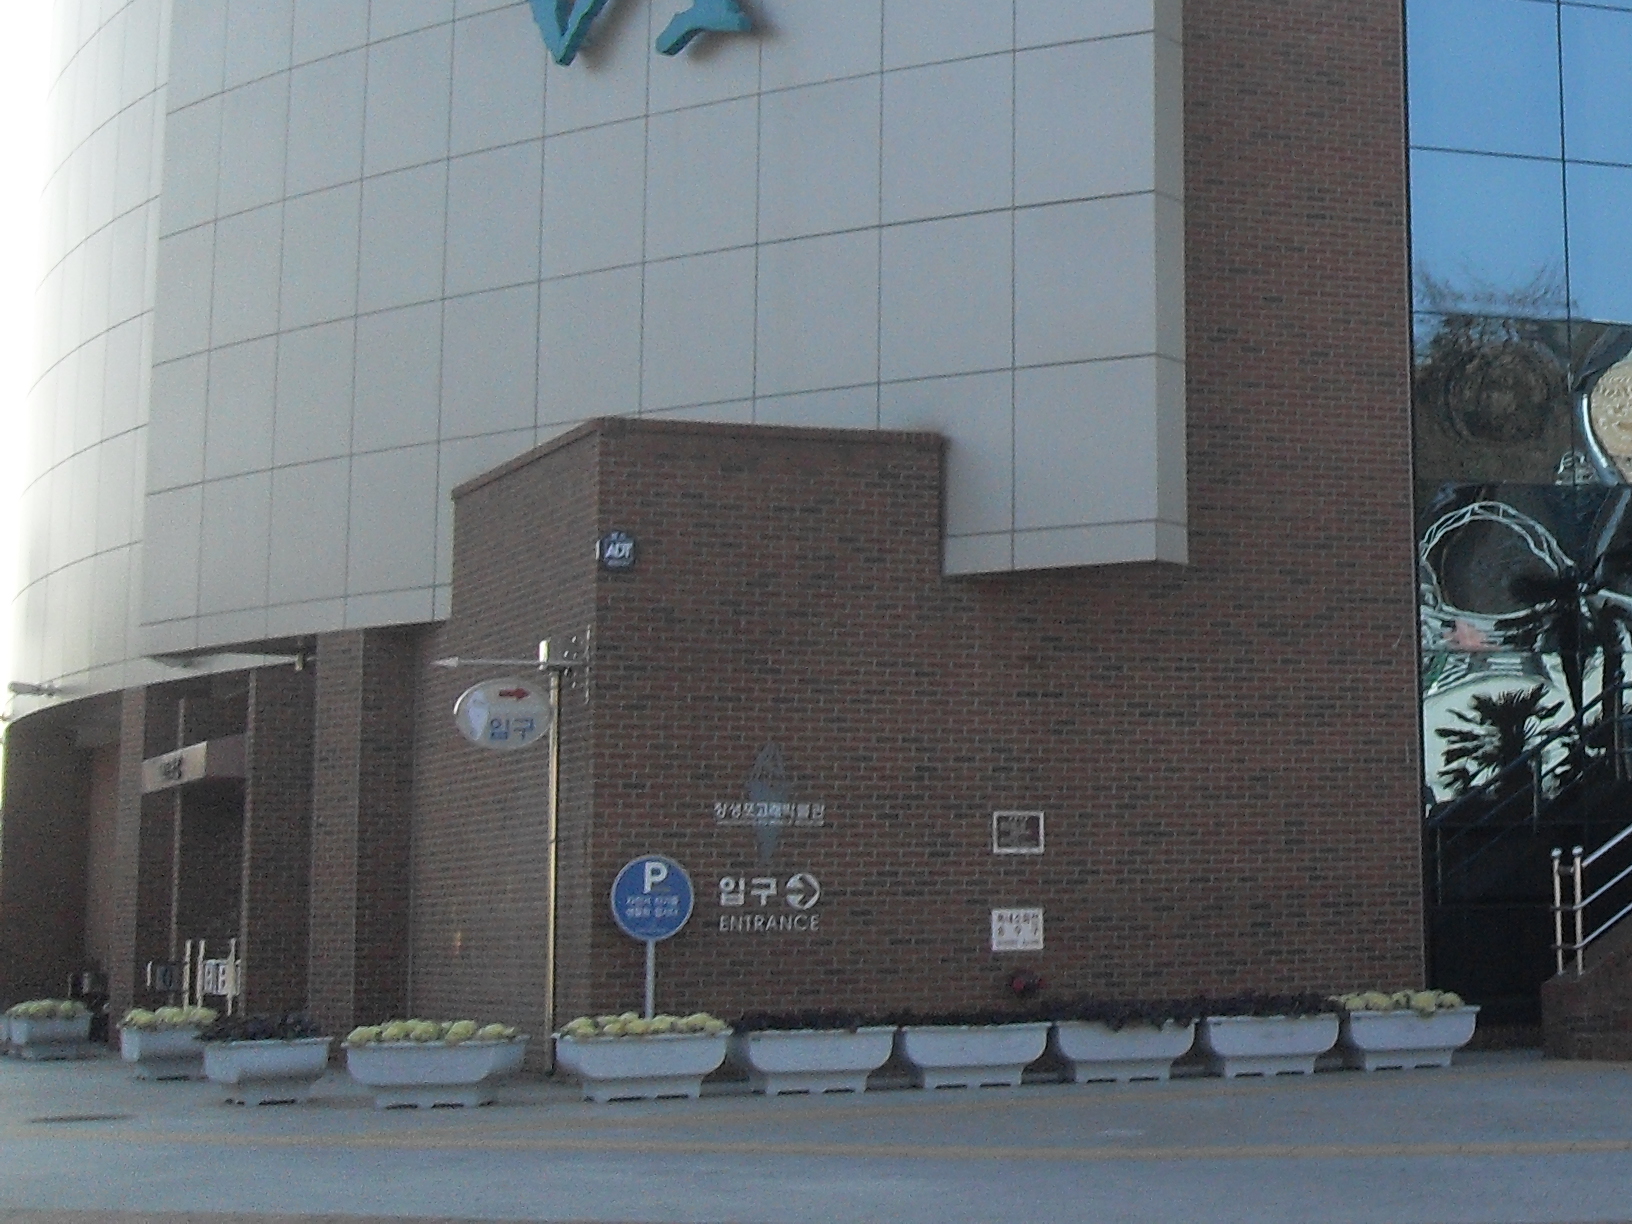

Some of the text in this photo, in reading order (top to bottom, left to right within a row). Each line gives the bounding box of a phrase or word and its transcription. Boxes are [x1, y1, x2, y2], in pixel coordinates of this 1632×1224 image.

[605, 542, 633, 559] ADT
[490, 718, 535, 740] 입구
[643, 861, 668, 894] P
[719, 877, 778, 907] 입구
[719, 915, 821, 932] ENTRANCE
